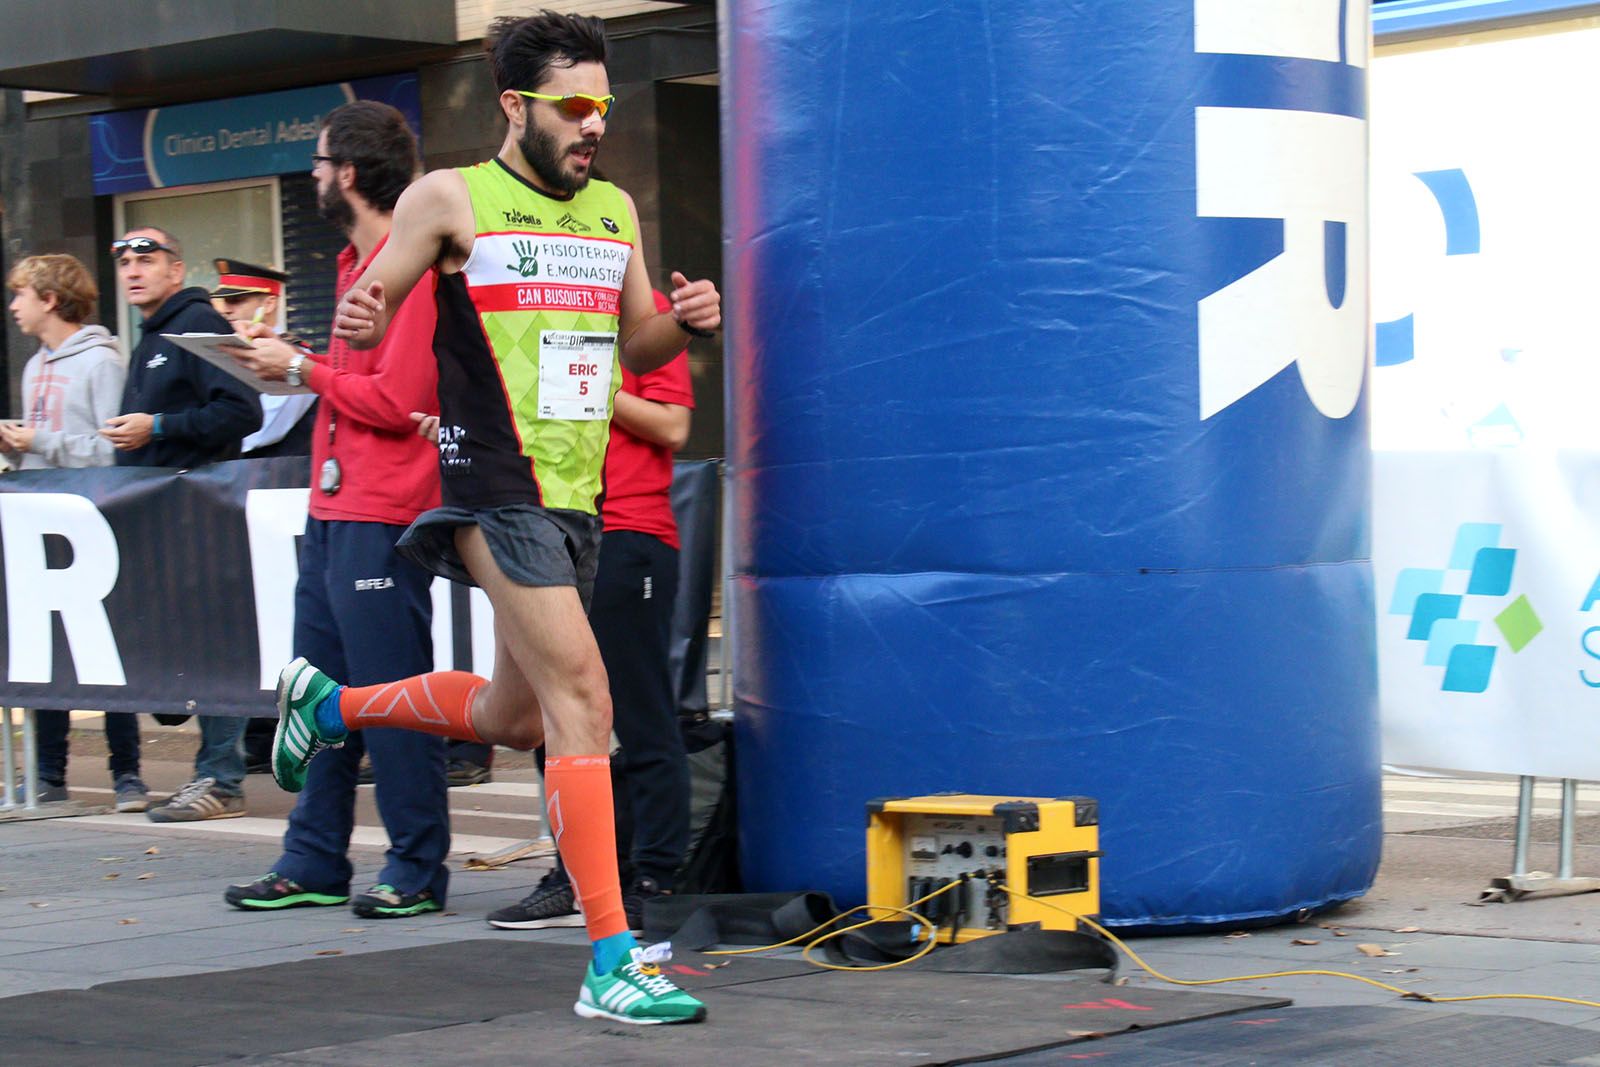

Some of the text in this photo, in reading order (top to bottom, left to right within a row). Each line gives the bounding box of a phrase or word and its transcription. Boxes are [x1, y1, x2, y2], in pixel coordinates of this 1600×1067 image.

[219, 121, 271, 150] Dental
[543, 243, 625, 263] FISIOTERAPIA
[517, 288, 541, 304] CAN
[544, 289, 594, 306] BUSQUETS
[568, 363, 598, 376] ERIC
[578, 381, 589, 396] 5
